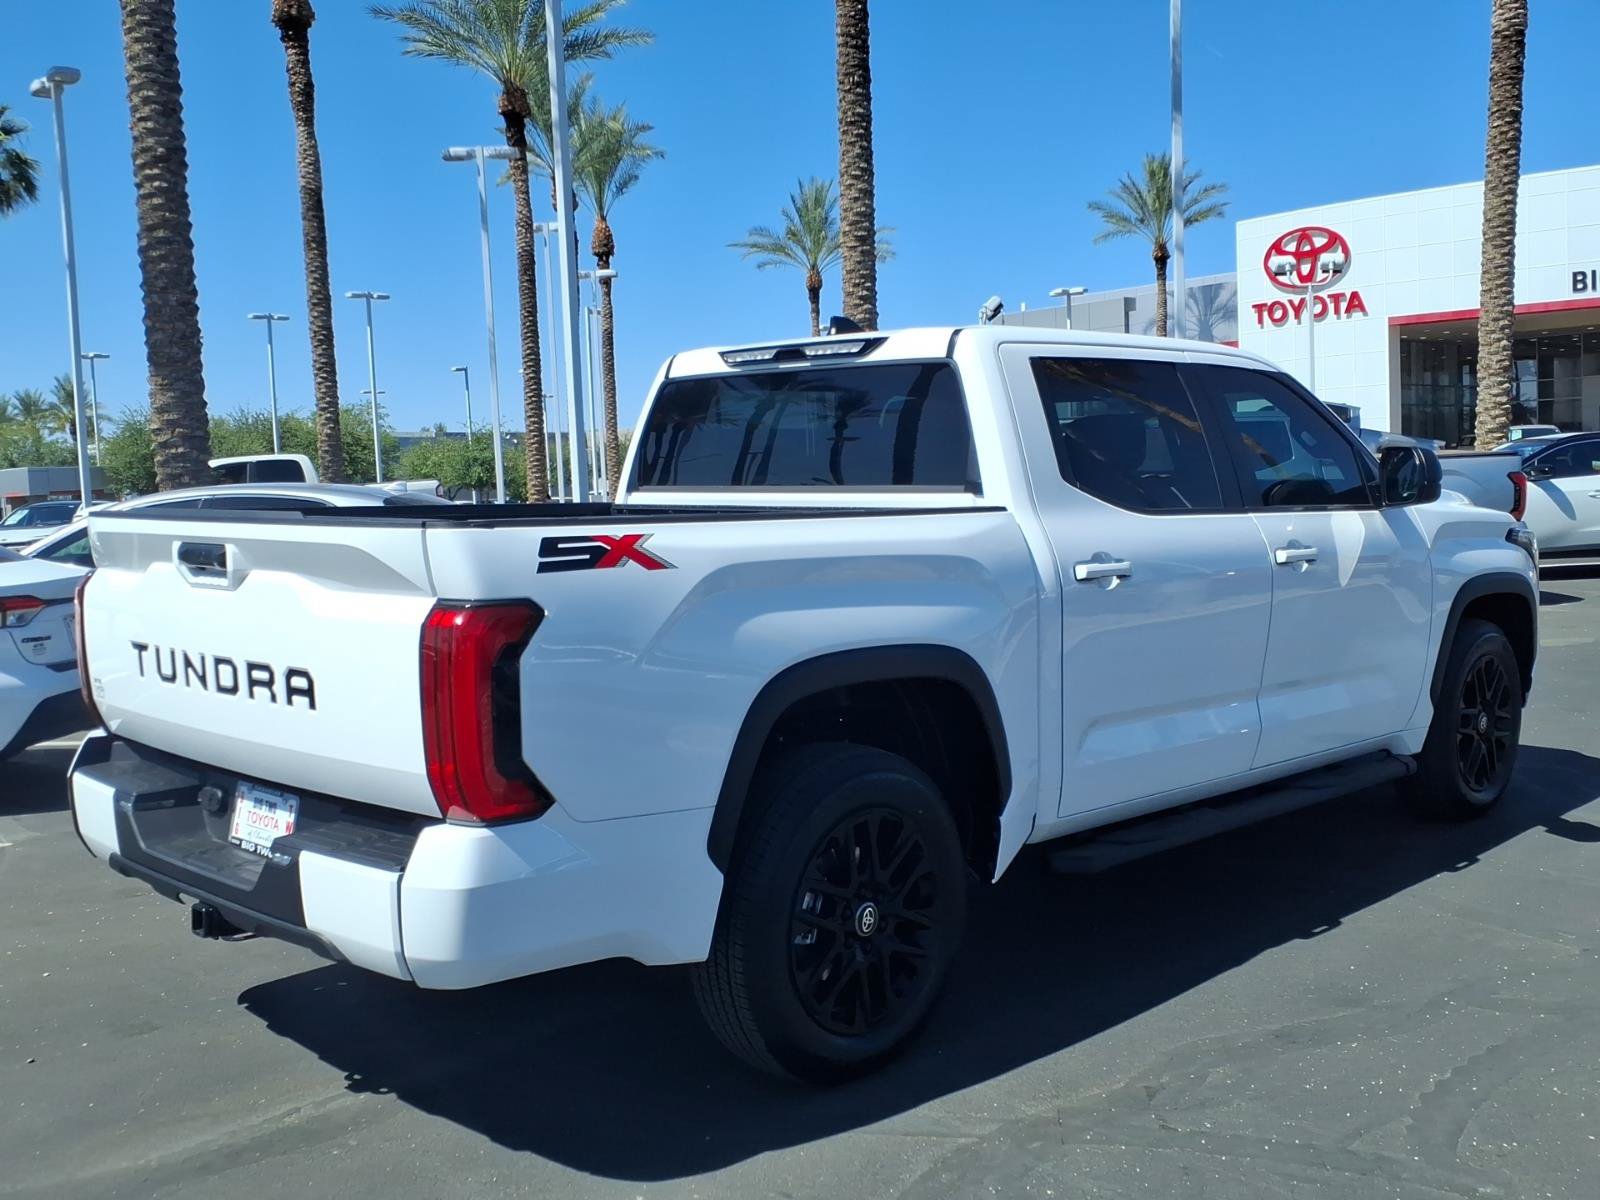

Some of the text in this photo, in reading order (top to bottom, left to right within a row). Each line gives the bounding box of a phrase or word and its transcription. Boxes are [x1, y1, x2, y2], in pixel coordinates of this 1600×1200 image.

[1252, 291, 1368, 328] TOYOTA
[130, 640, 316, 711] TUNDRA
[248, 810, 279, 832] TOYOTA
[241, 840, 256, 852] BIG
